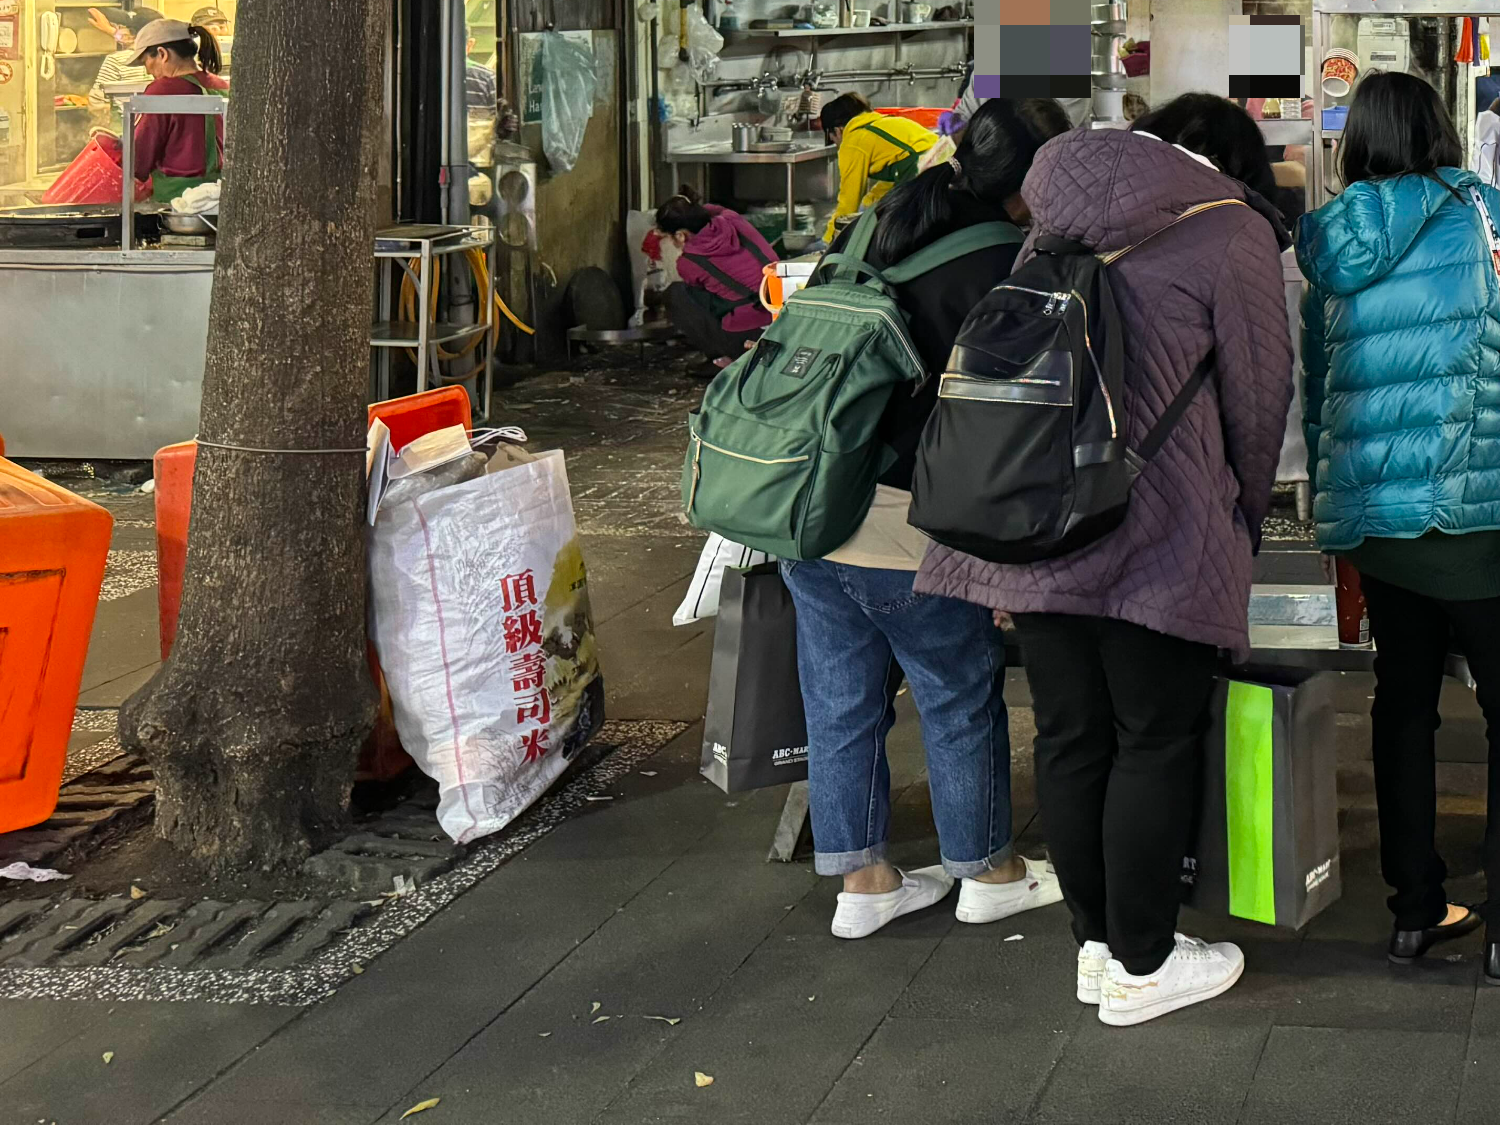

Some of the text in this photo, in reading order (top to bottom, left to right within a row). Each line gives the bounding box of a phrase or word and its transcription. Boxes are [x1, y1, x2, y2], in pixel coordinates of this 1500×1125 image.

[498, 568, 552, 766] 頂級壽司米
